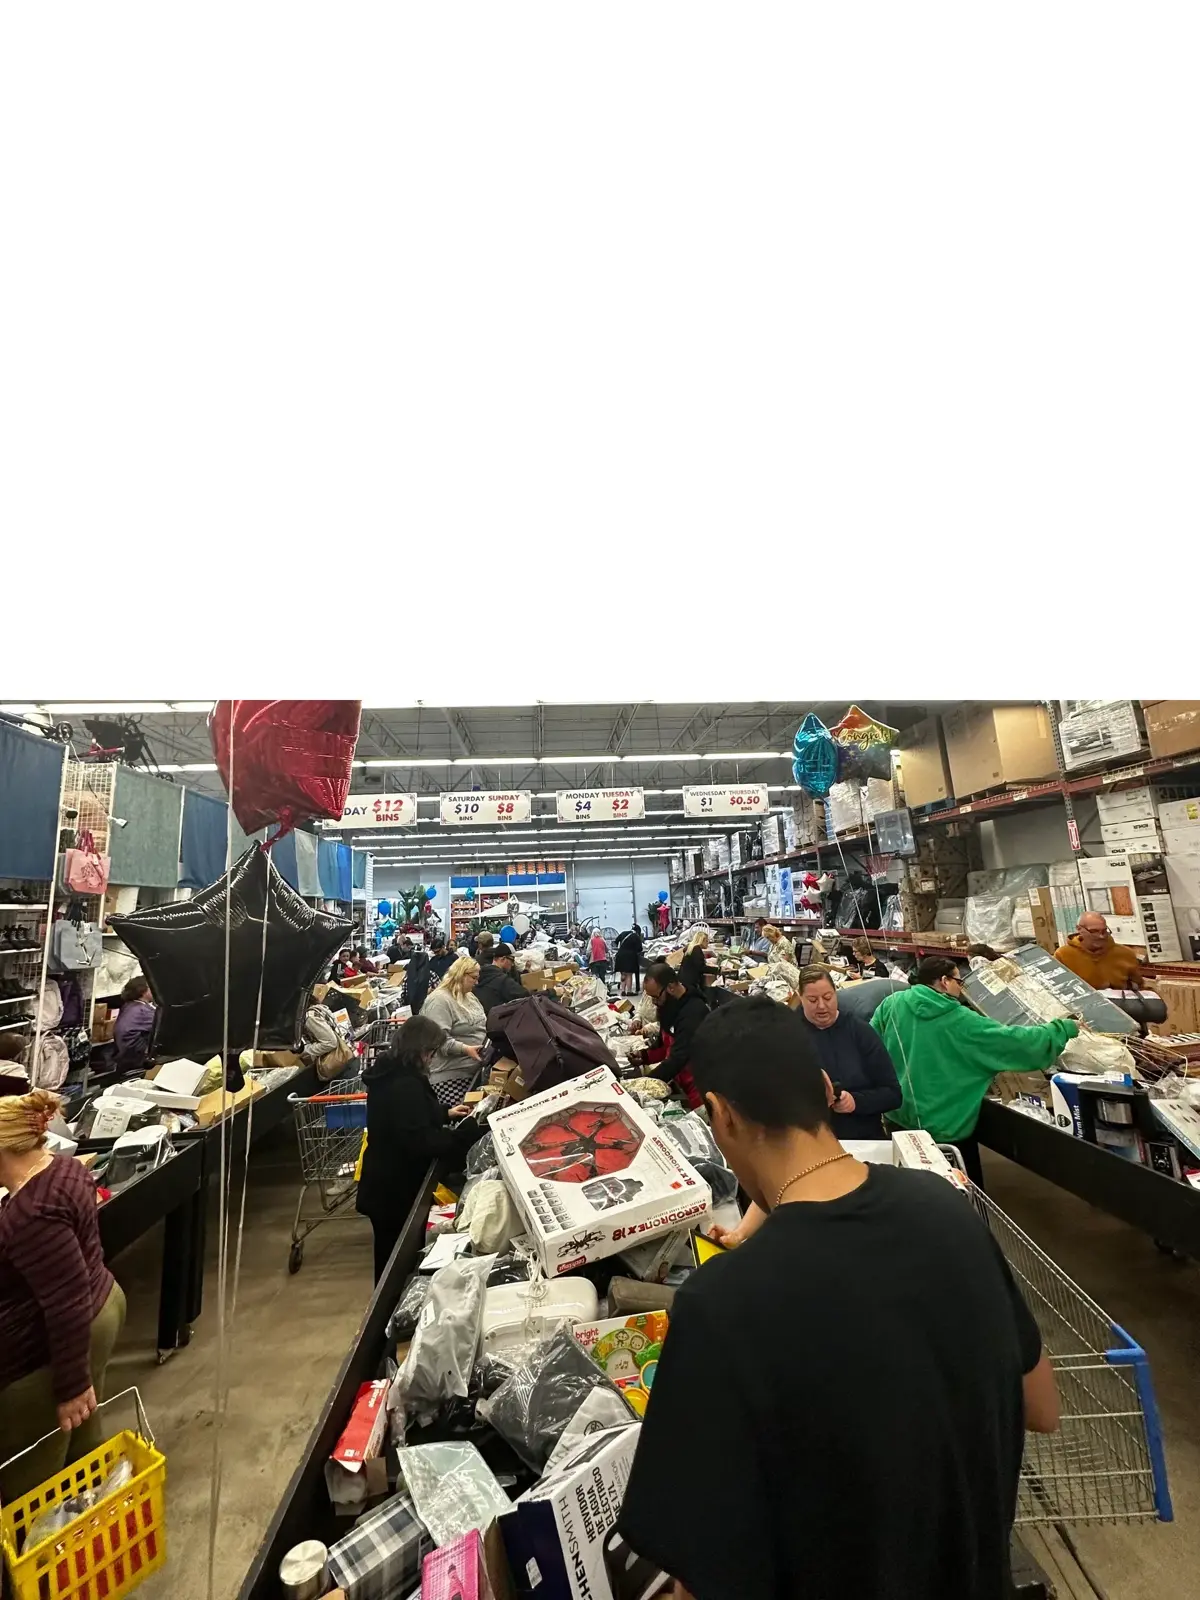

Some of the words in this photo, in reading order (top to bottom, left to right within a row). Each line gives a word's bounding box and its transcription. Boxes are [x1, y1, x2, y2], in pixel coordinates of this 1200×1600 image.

[833, 728, 892, 751] Congrats!
[344, 807, 368, 815] DAY
[372, 799, 404, 813] $12
[454, 803, 479, 815] $10
[497, 802, 514, 814] $8
[575, 800, 591, 813] $4
[612, 798, 629, 811] $2
[701, 797, 712, 807] $1
[730, 796, 760, 806] $0.50
[376, 813, 399, 822] BINS
[496, 1098, 550, 1122] AERODRONE
[652, 1136, 684, 1173] AERODRONE
[638, 1202, 707, 1232] AERODRONE
[576, 1328, 598, 1339] bright
[587, 1485, 600, 1517] AGUA
[575, 1484, 596, 1544] HERVIDOR
[595, 1516, 605, 1535] DE
